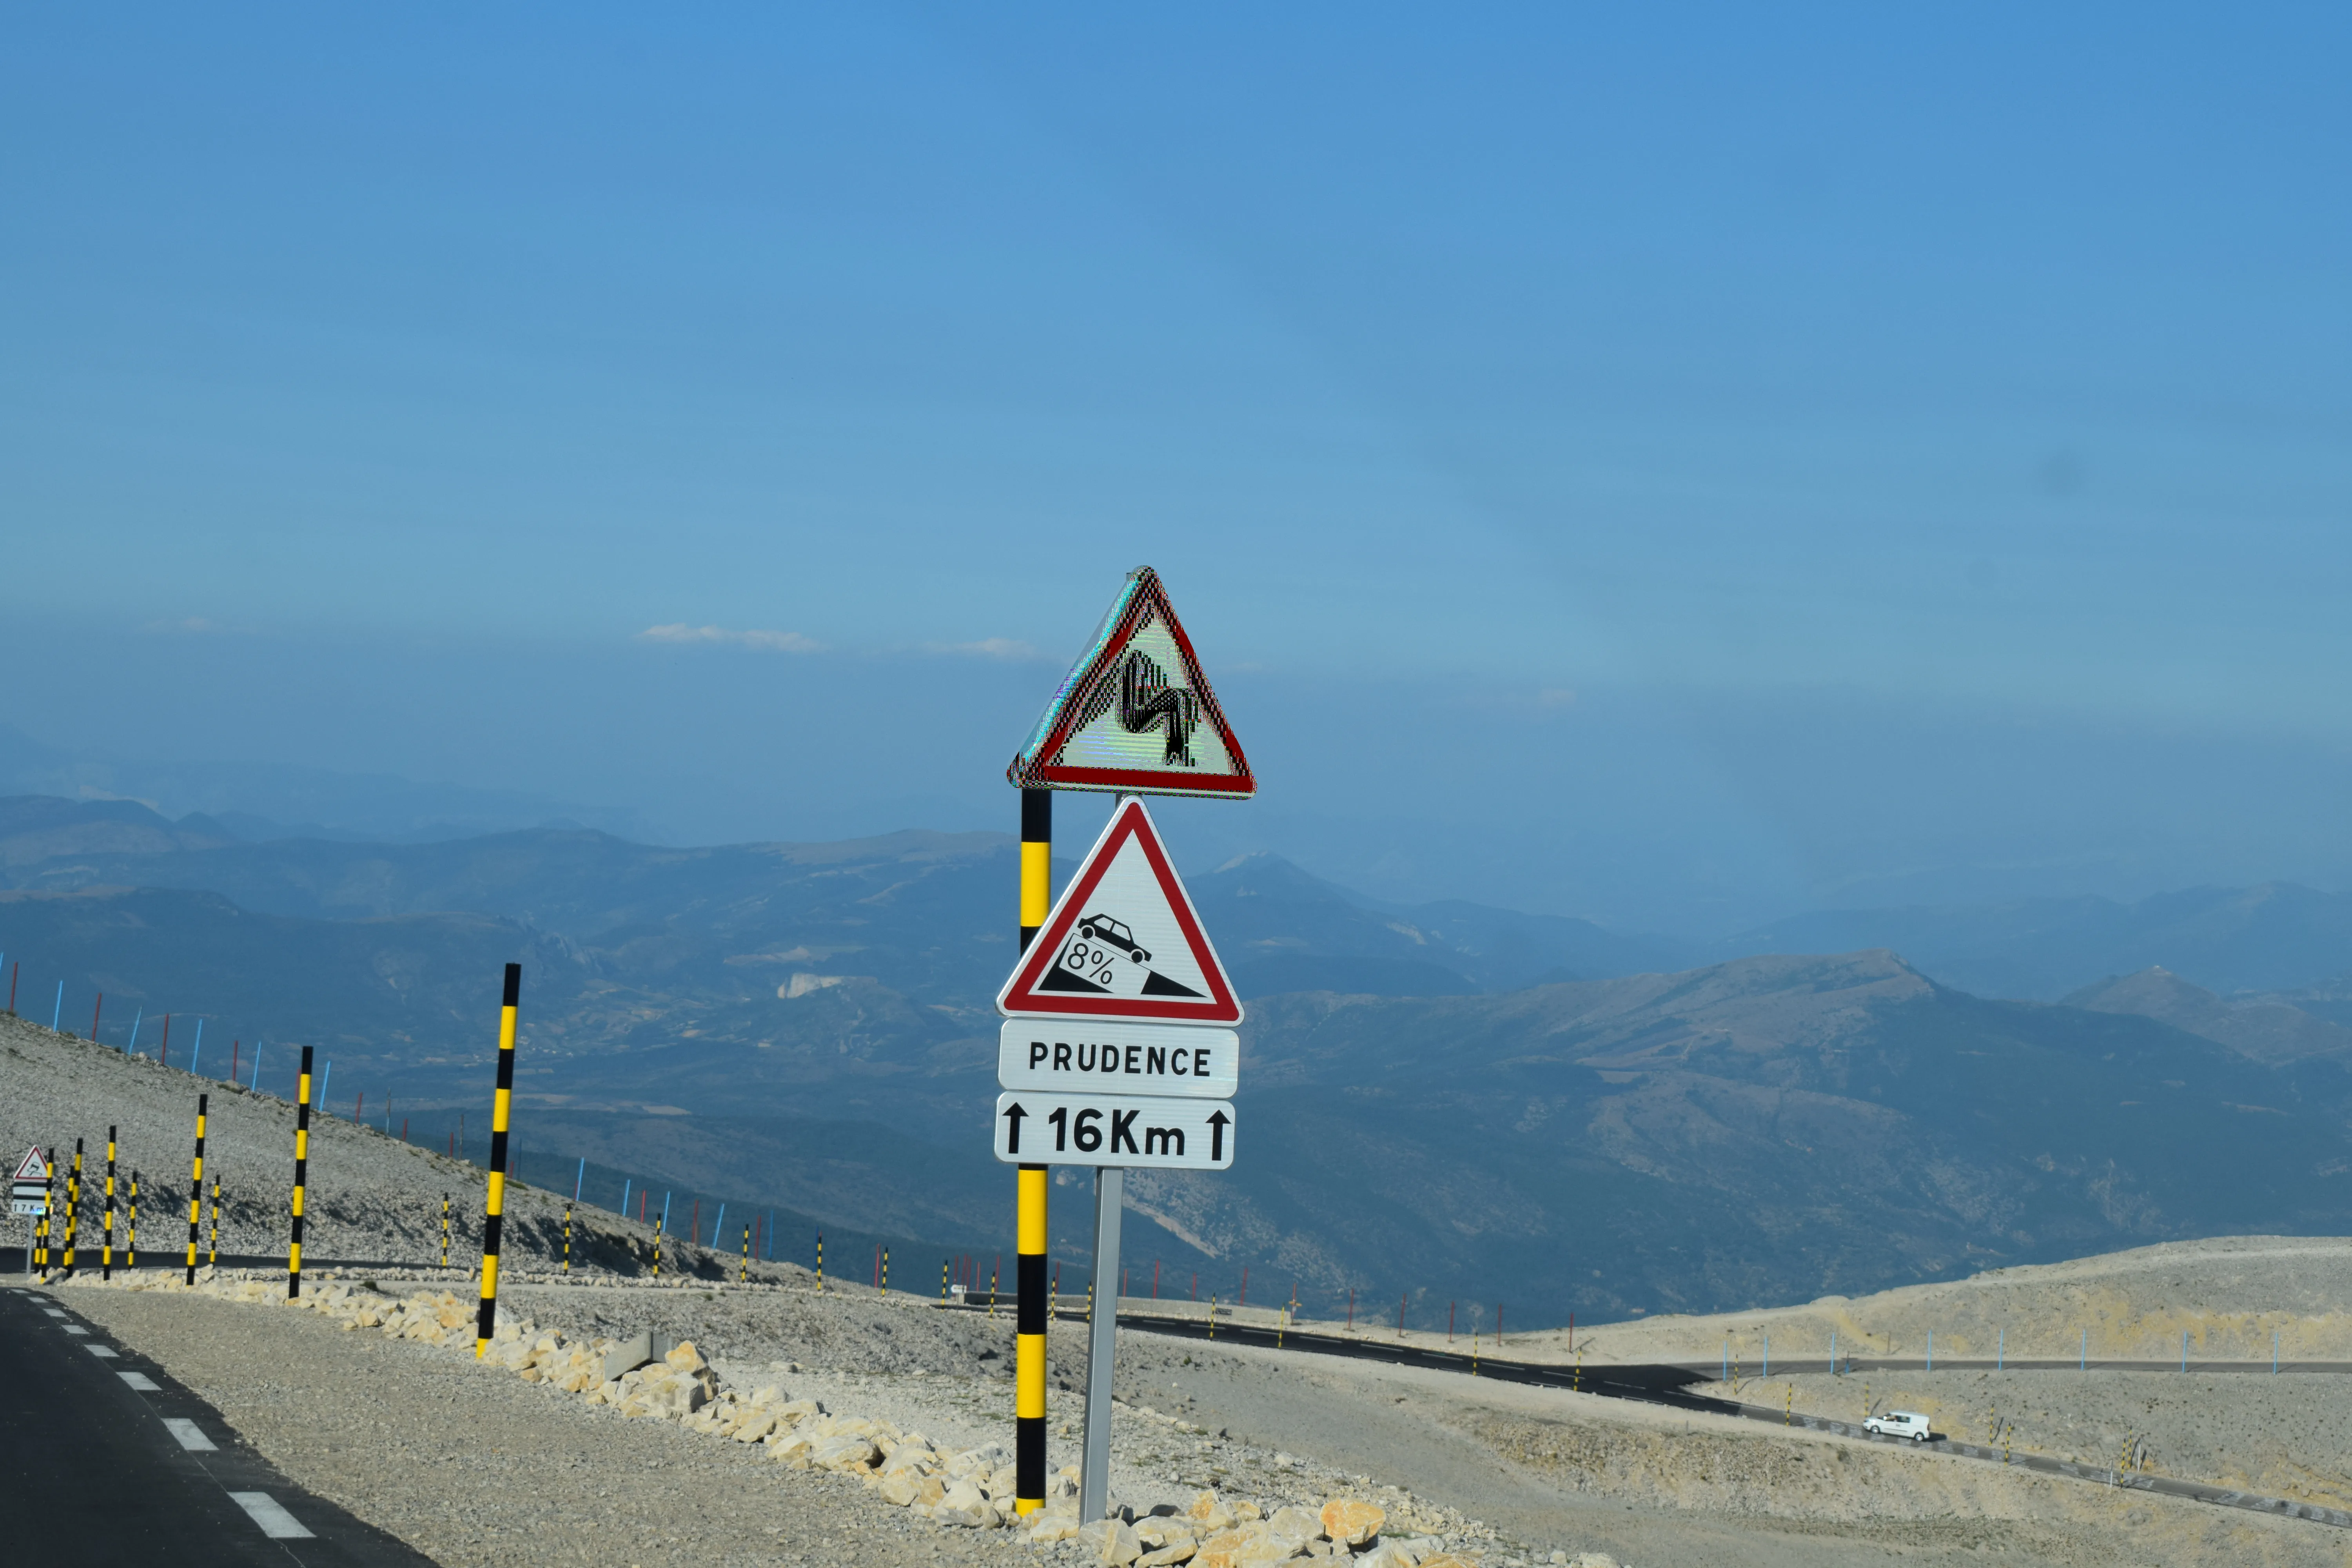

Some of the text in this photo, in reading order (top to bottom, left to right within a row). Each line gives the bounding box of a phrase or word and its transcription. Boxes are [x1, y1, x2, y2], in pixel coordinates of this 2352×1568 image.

[1067, 942, 1115, 985] 8%
[1029, 1041, 1211, 1077] PRUDENCE
[1048, 1107, 1185, 1156] 16Km
